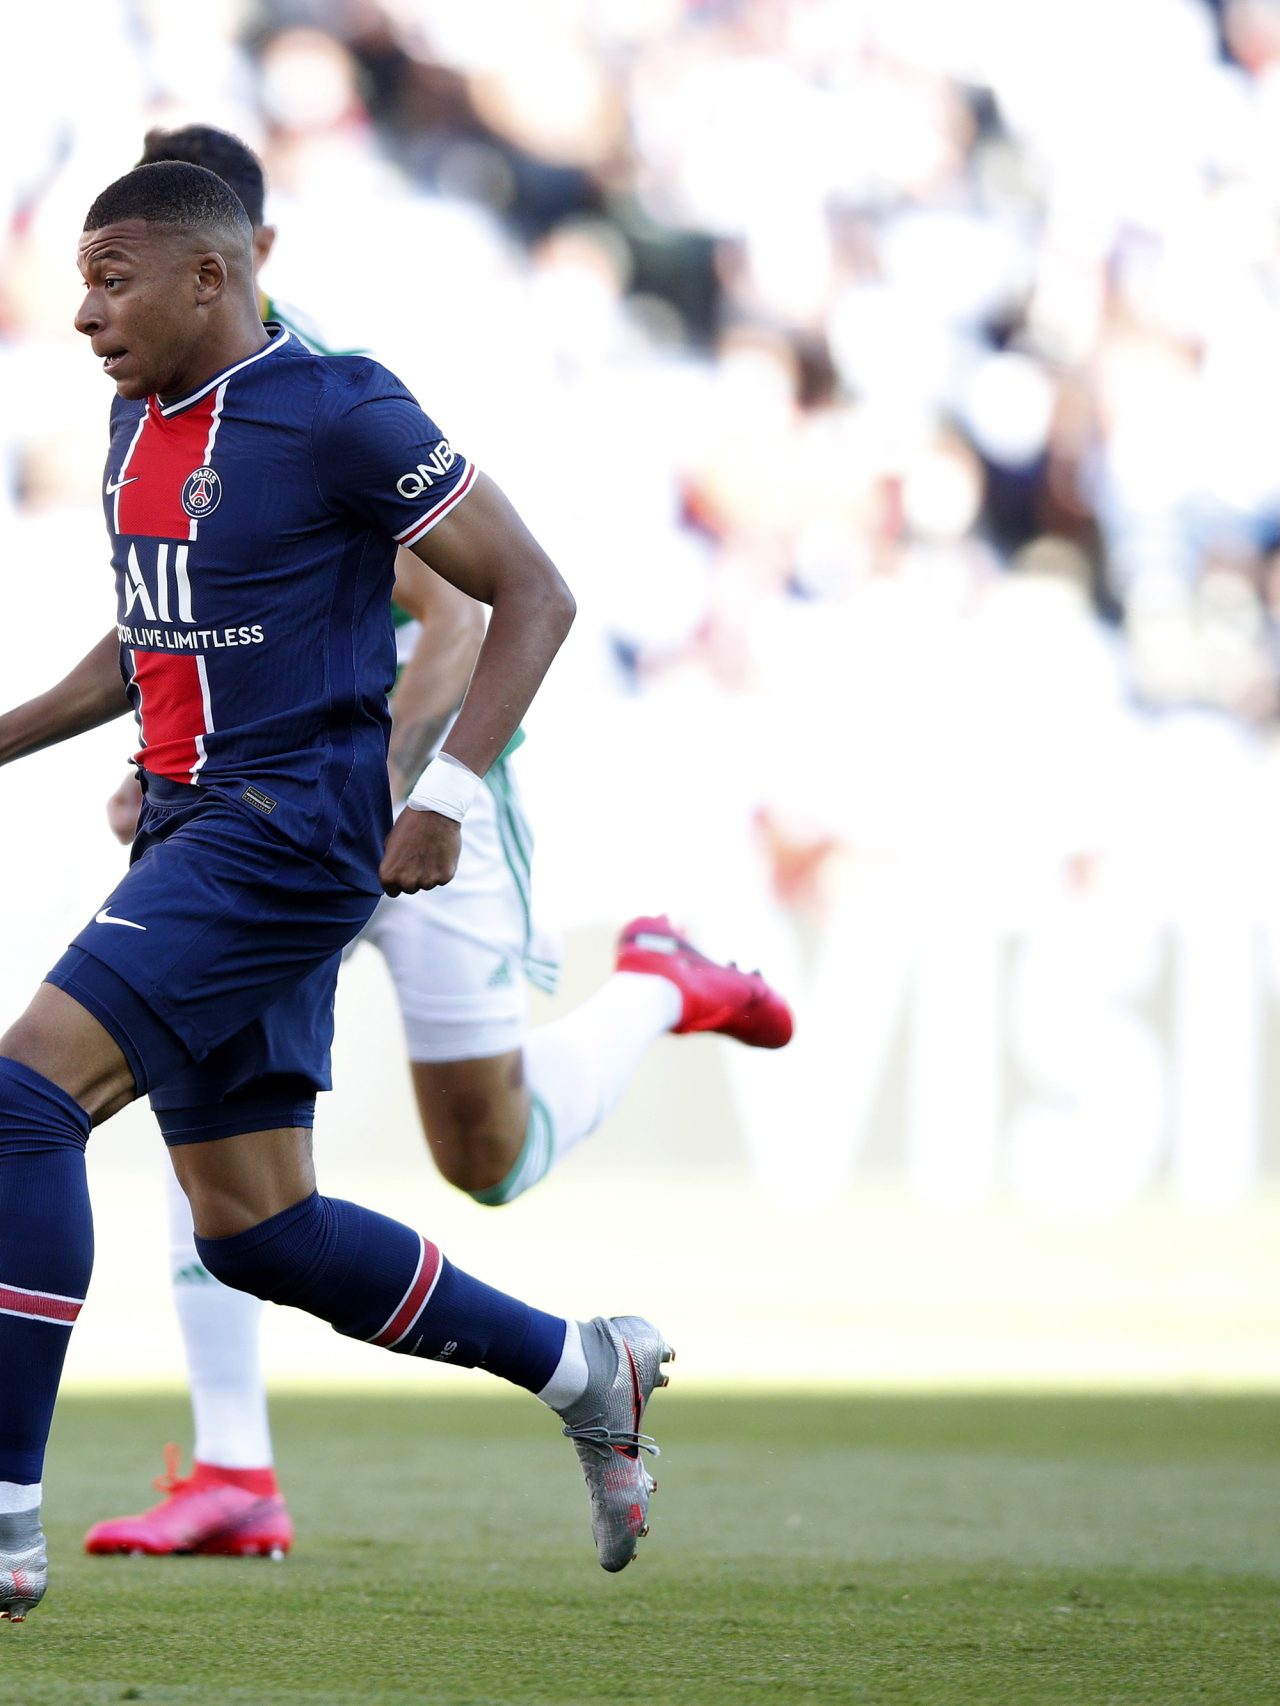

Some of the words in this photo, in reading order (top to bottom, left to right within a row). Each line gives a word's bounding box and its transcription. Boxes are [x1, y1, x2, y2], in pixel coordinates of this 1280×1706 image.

[192, 470, 217, 484] PARIS
[396, 440, 455, 499] QNB
[134, 627, 164, 648] LIVE
[165, 624, 265, 649] LIMITLESS
